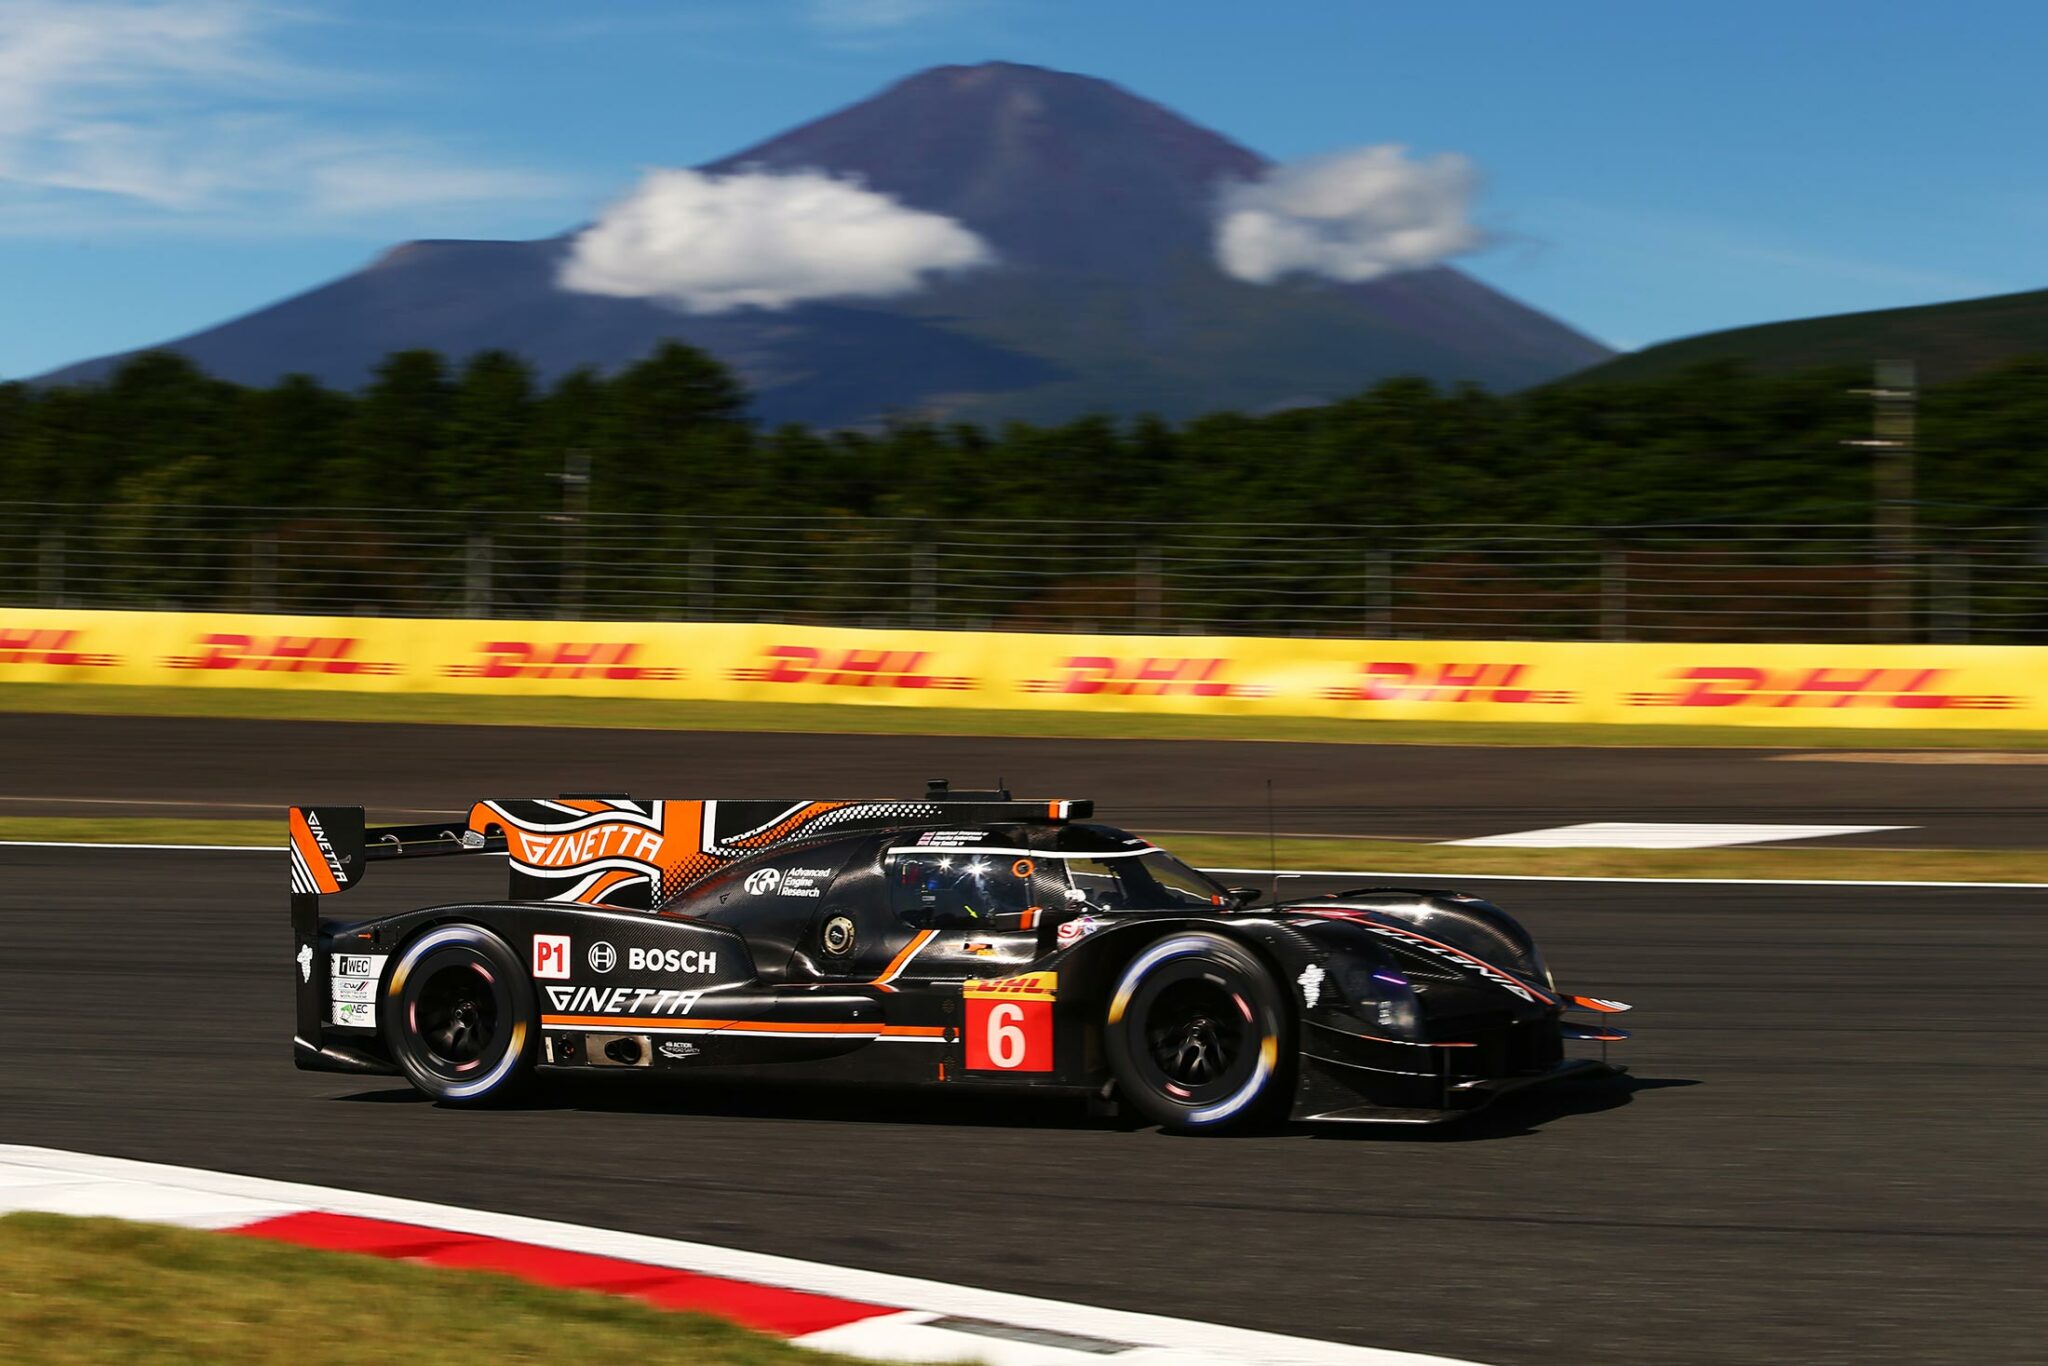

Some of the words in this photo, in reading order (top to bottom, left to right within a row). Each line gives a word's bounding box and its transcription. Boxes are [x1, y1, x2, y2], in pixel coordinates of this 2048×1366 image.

[0, 628, 82, 665] HL
[195, 634, 366, 674] DHL
[478, 641, 644, 679] DHL
[762, 645, 933, 688] DHL
[1060, 656, 1233, 696] DHL
[1362, 662, 1533, 703] DHL
[1675, 667, 1957, 709] DHL
[308, 810, 348, 882] GINETTA
[518, 825, 665, 866] GINETTA
[784, 876, 814, 888] Engine
[787, 867, 831, 877] Advanced
[781, 887, 820, 897] Research
[537, 942, 563, 973] P1
[628, 947, 717, 974] BOSCH
[544, 985, 706, 1015] GINETTA
[976, 978, 1044, 994] DHL
[987, 1003, 1026, 1069] 6
